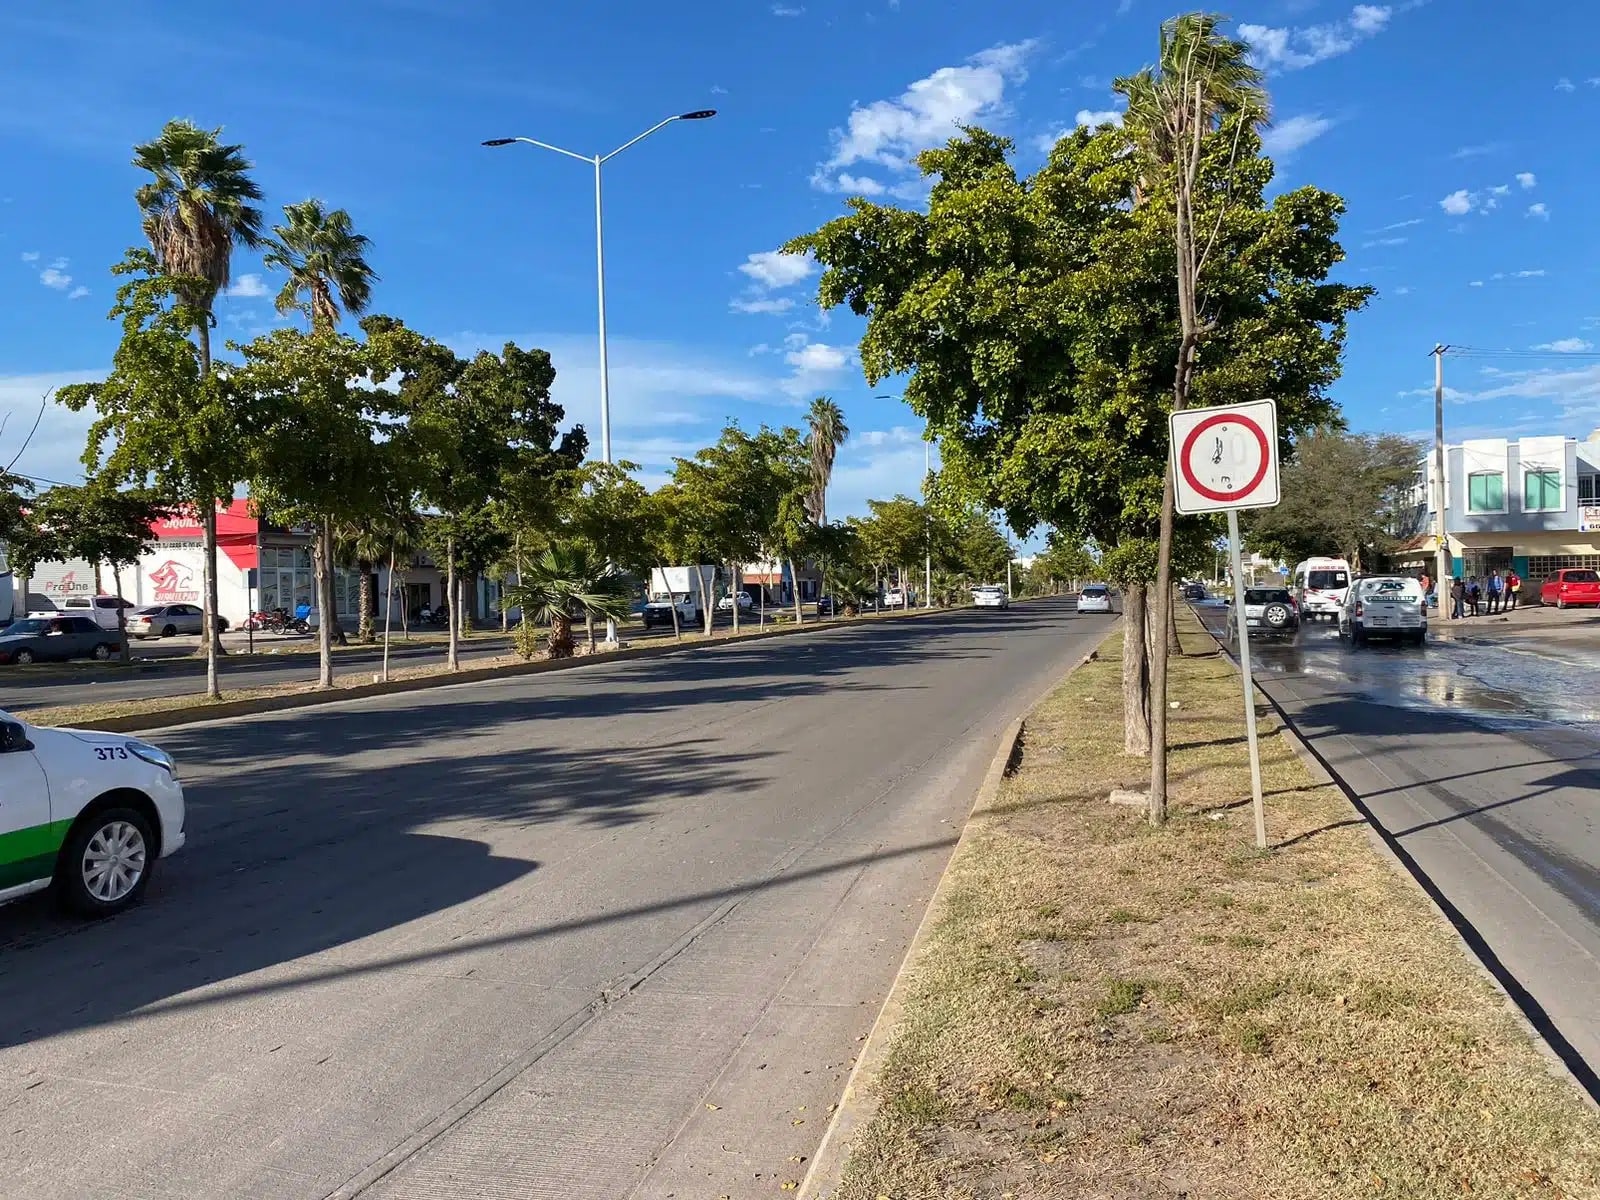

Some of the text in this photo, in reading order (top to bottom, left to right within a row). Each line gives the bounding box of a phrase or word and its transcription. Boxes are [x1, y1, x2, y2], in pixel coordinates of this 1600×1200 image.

[45, 581, 88, 591] Pro One
[94, 747, 128, 760] 373
